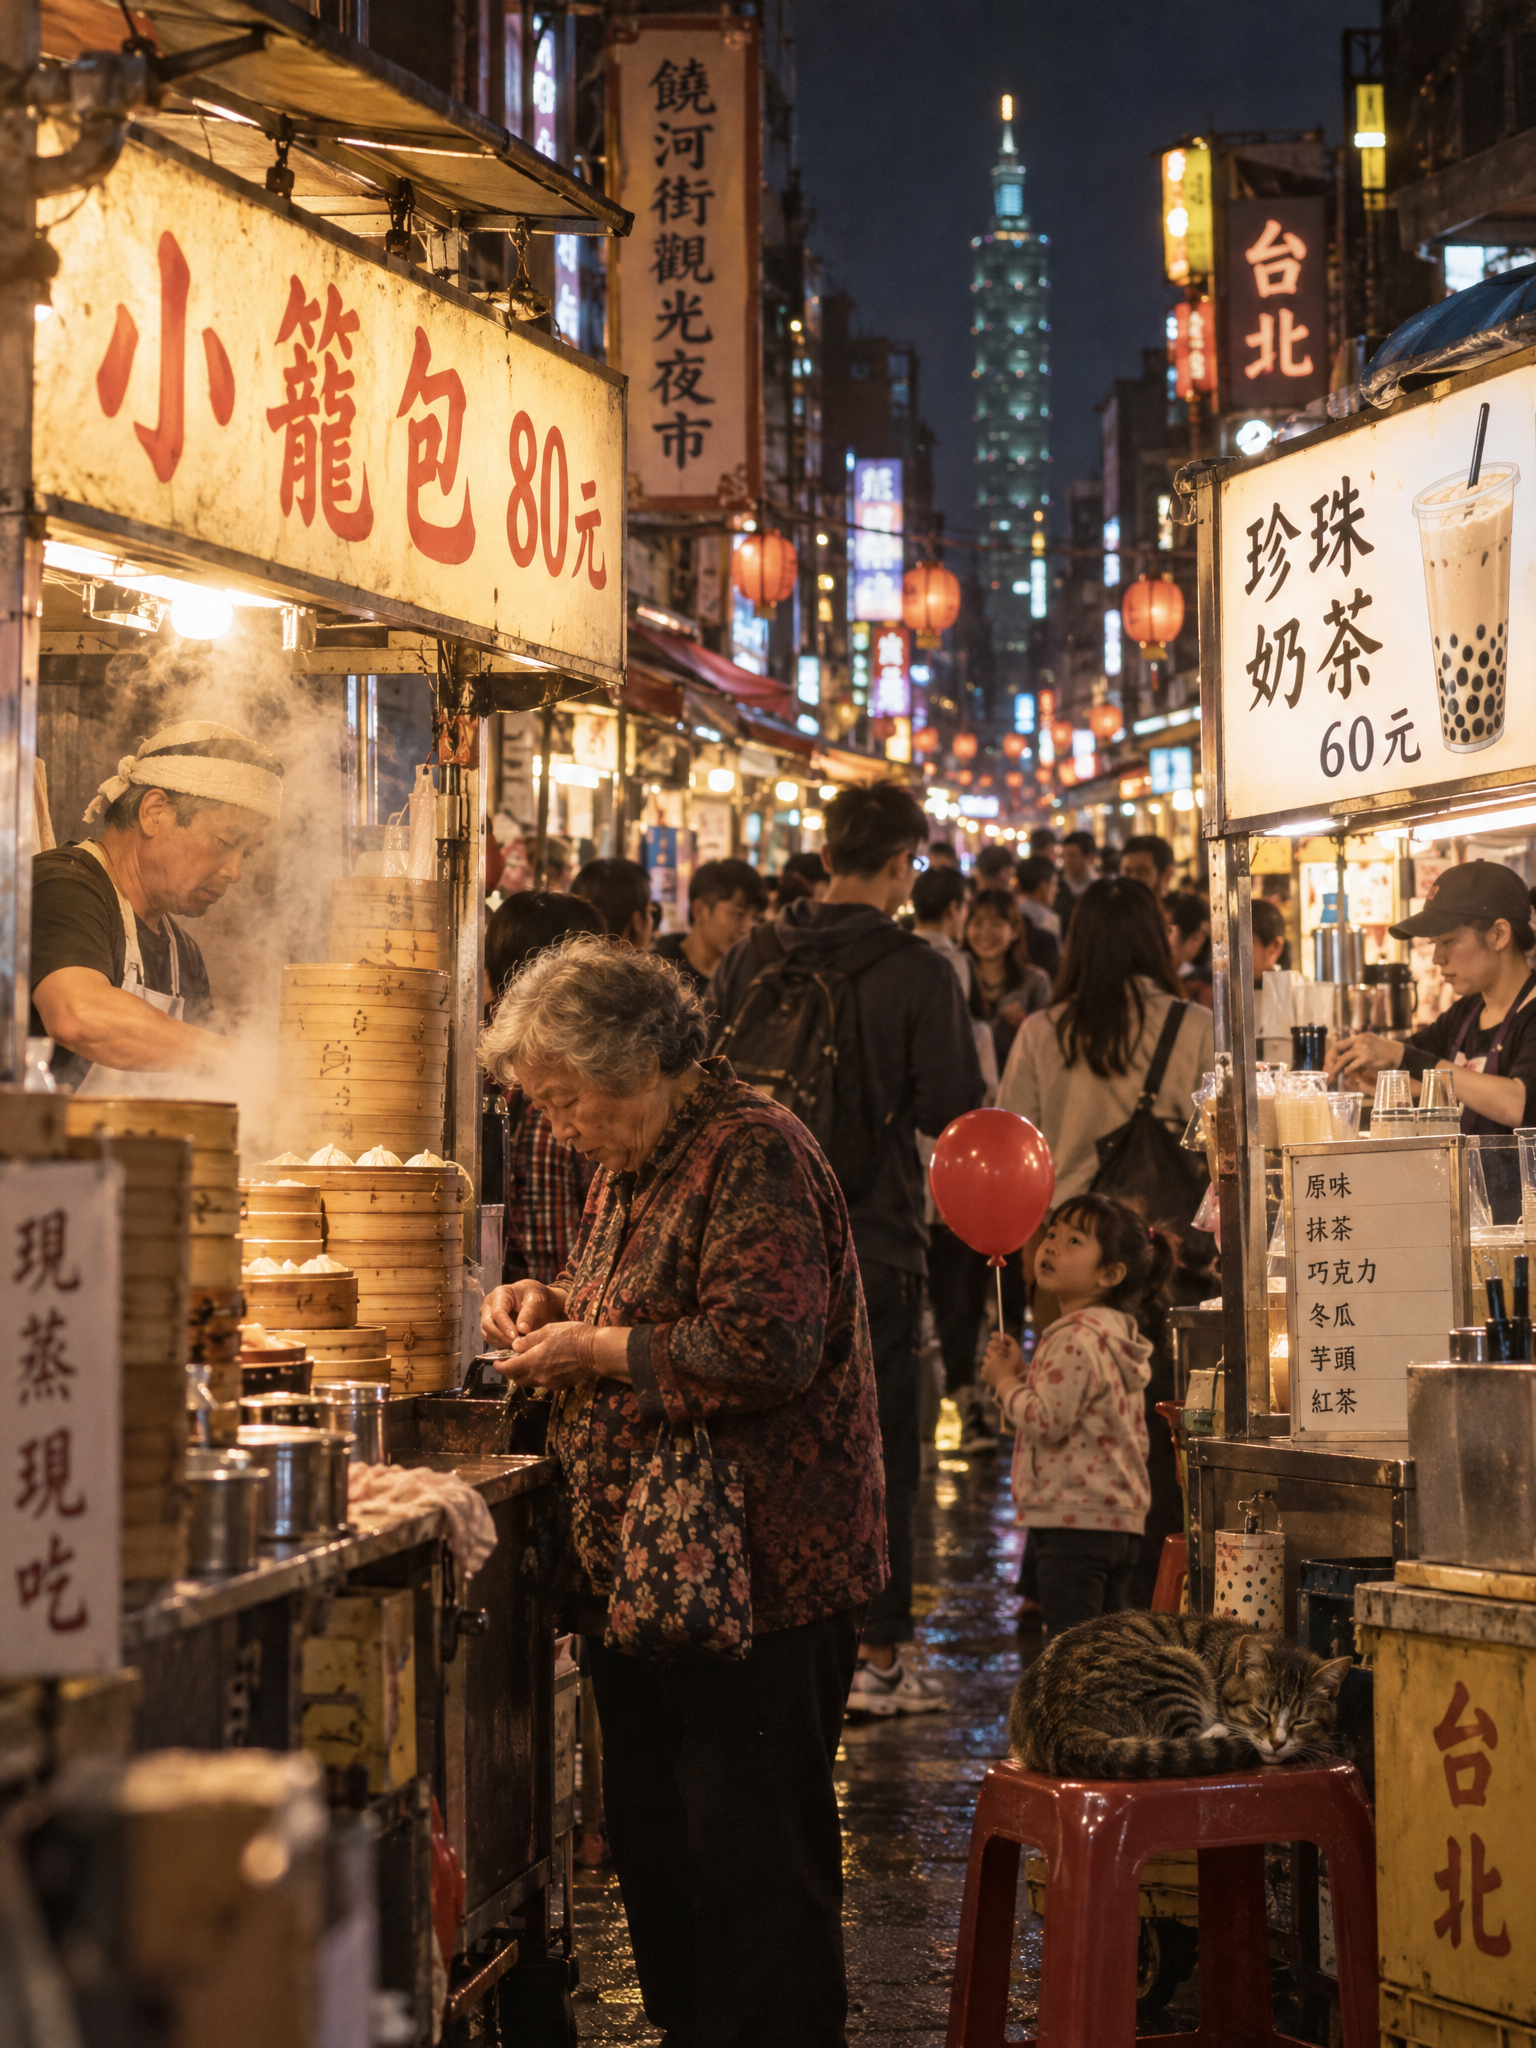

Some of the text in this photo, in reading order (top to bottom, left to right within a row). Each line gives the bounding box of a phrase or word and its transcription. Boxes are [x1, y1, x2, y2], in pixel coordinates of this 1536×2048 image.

[649, 57, 716, 470] 饒河街觀光夜市
[1244, 219, 1314, 380] 台北
[96, 230, 474, 566] 小籠包
[505, 410, 608, 591] 80元
[1244, 475, 1375, 603] 珍珠
[1246, 588, 1384, 712] 奶茶
[1319, 708, 1422, 778] 60元
[1305, 1172, 1352, 1199] 原味
[1306, 1215, 1353, 1242] 抹茶
[1307, 1258, 1376, 1285] 巧克力
[1309, 1302, 1355, 1329] 冬瓜
[1310, 1345, 1356, 1372] 芋頭
[1311, 1388, 1357, 1415] 紅茶
[12, 1206, 88, 1634] 現蒸現吃
[1433, 1680, 1512, 1958] 台北
